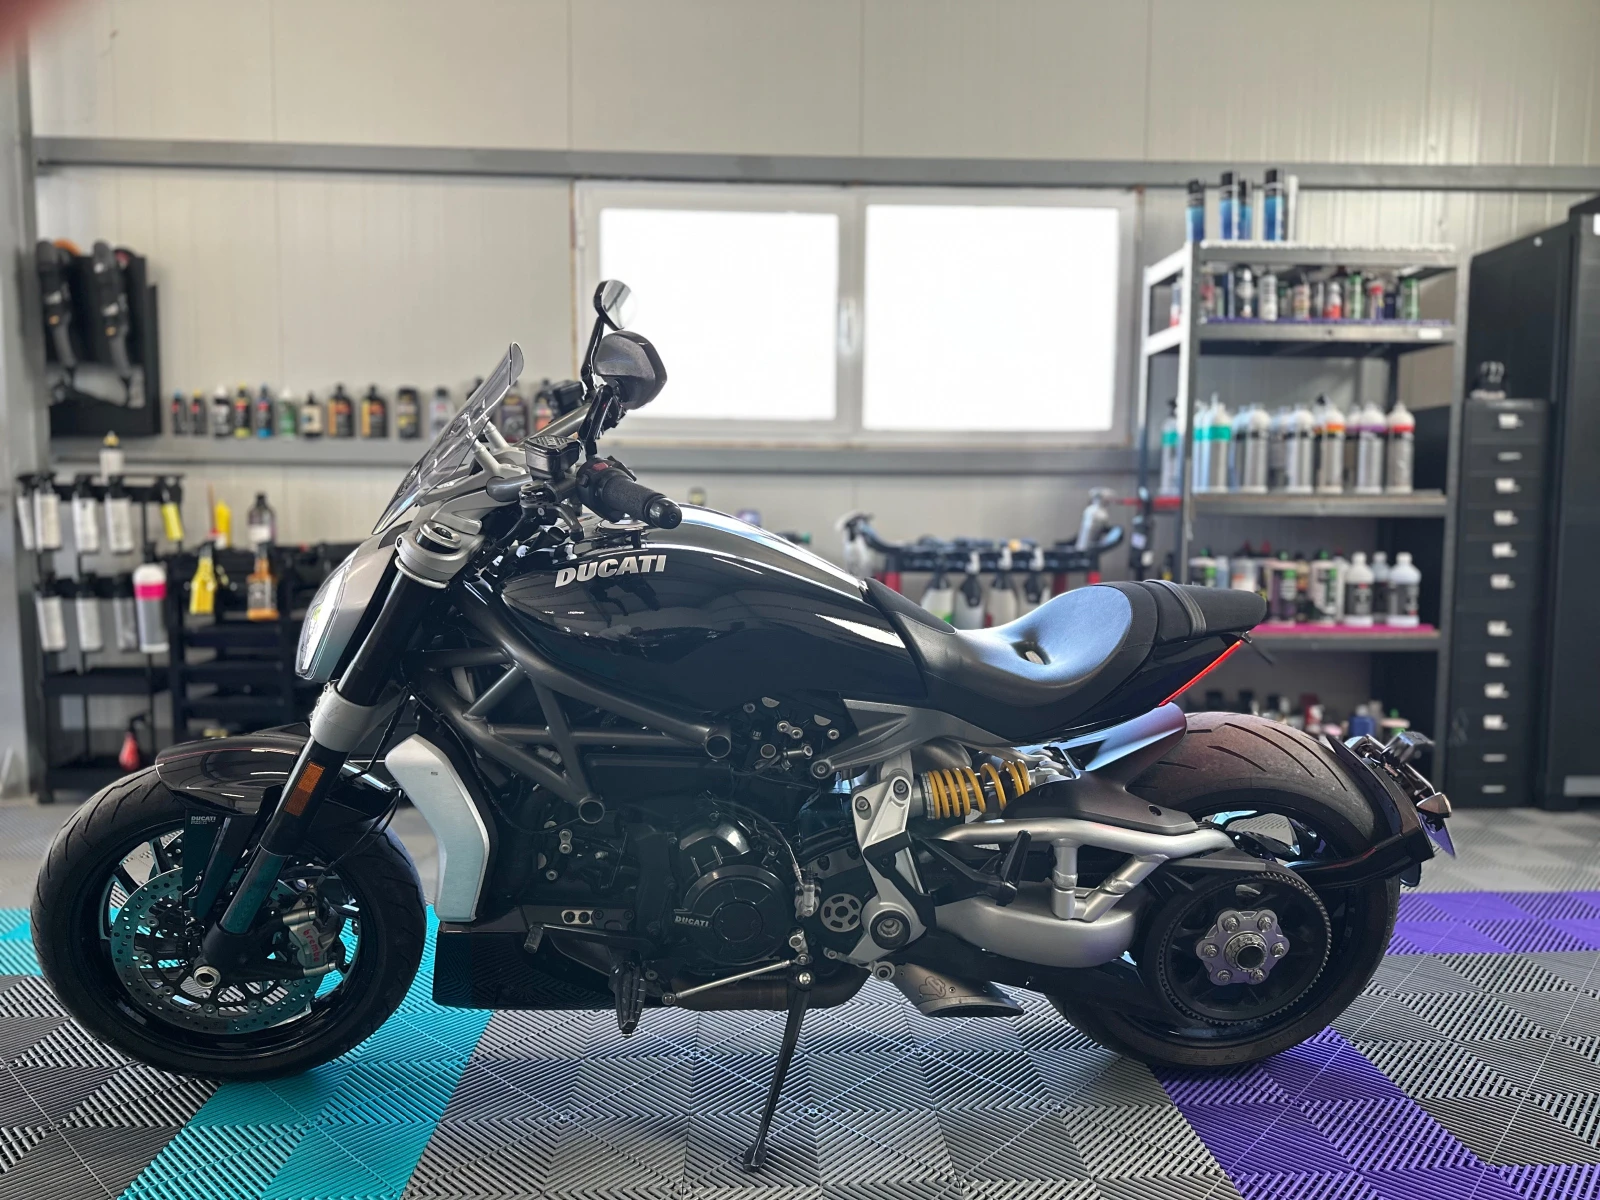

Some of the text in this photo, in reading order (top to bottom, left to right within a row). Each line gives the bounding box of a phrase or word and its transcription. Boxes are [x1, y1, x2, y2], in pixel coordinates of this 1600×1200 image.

[555, 555, 667, 588] DUCATI
[675, 915, 709, 928] DUCATI
[303, 928, 320, 962] brembo
